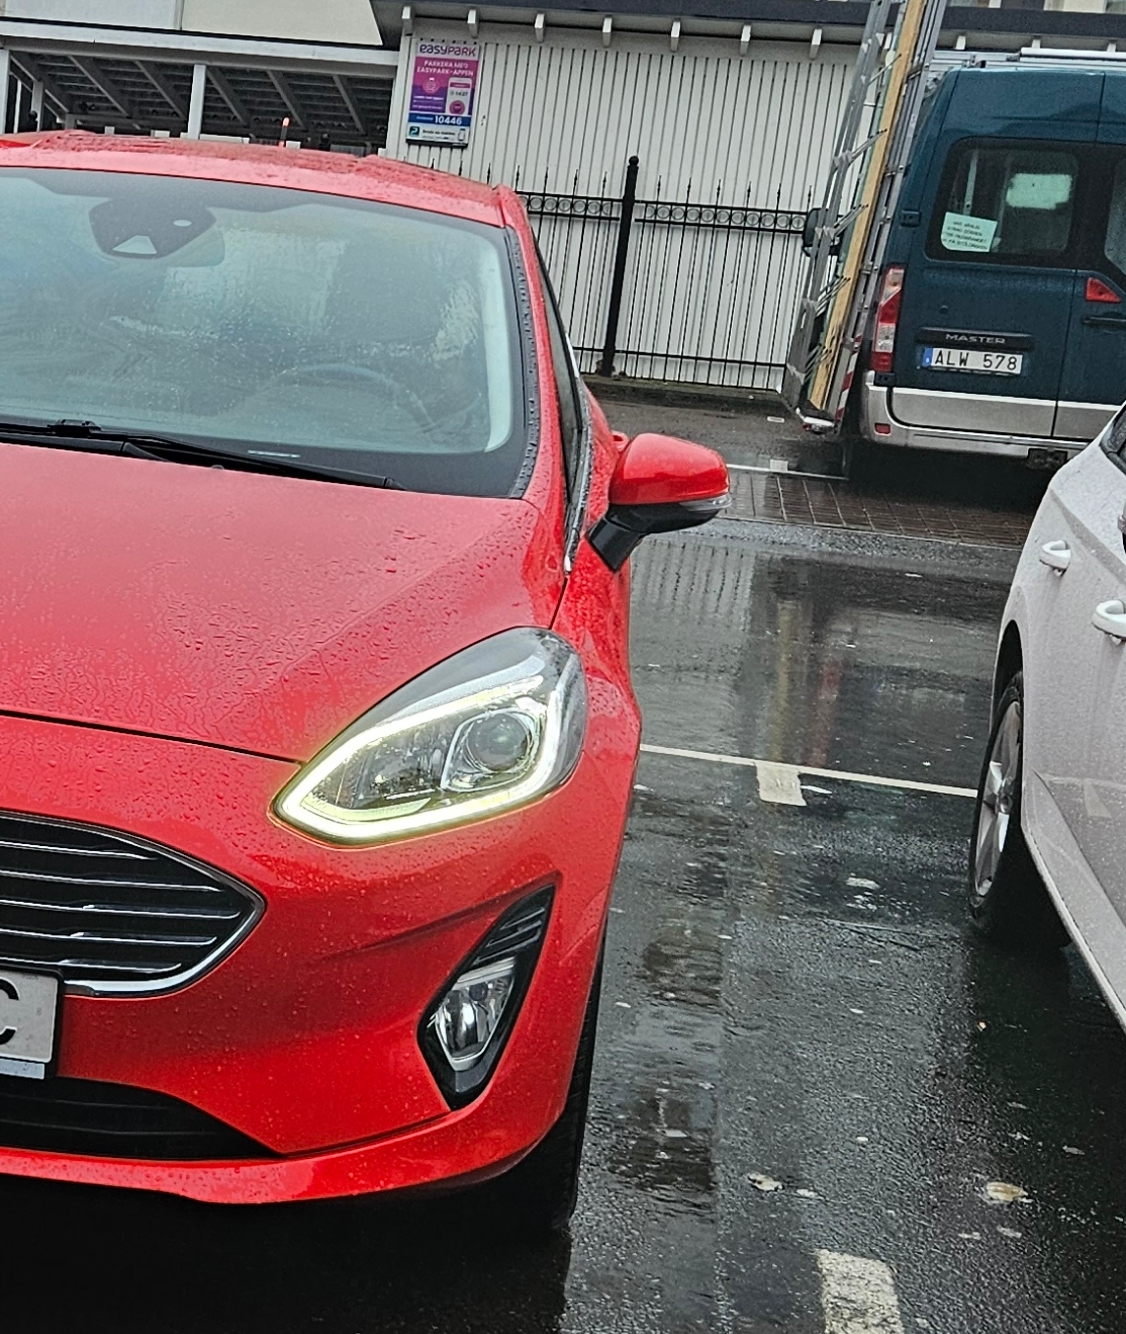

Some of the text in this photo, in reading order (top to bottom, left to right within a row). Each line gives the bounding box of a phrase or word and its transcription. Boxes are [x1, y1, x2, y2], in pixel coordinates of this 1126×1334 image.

[424, 59, 454, 68] PARKERA
[945, 333, 1006, 344] MASTER
[934, 349, 1017, 371] ALW 578
